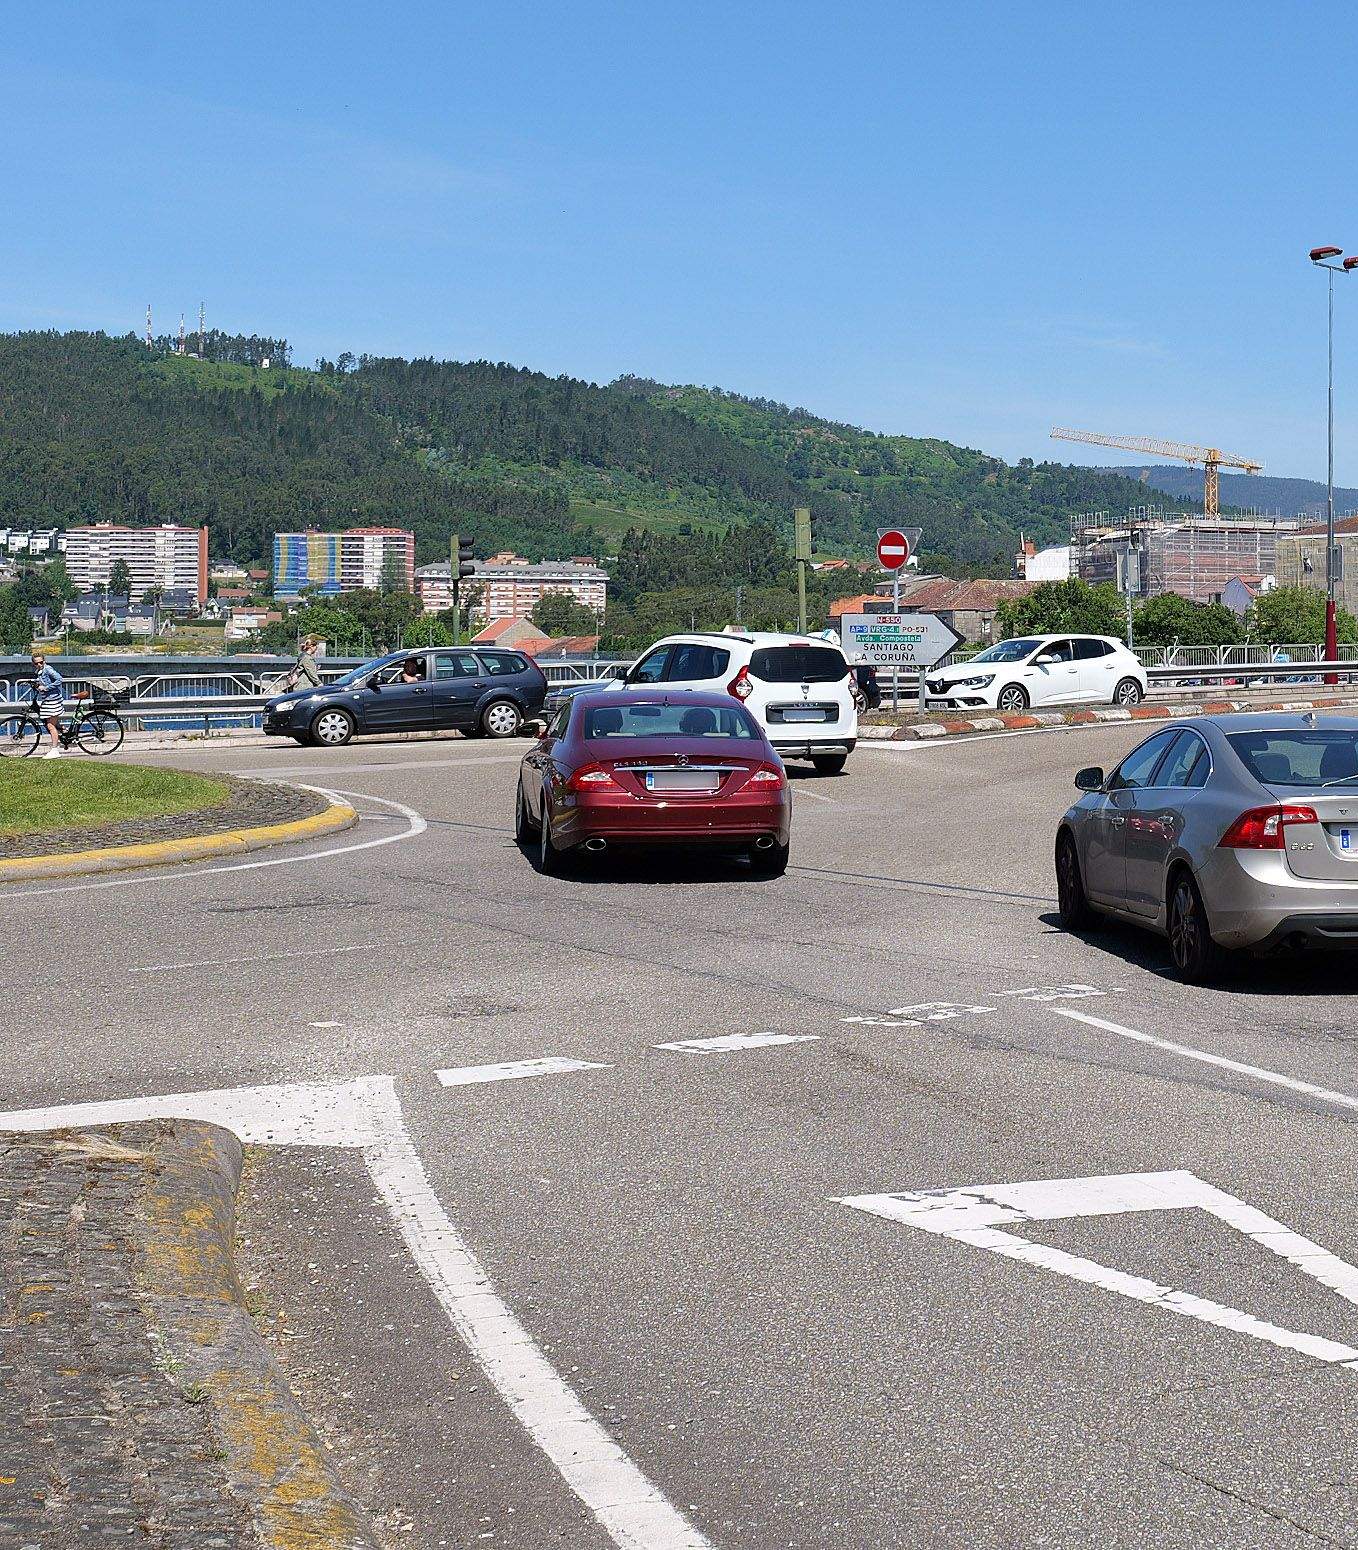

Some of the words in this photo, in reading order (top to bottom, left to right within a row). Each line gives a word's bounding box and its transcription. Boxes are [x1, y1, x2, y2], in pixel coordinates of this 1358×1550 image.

[877, 616, 901, 624] N-550
[850, 625, 868, 633] AP-9
[863, 643, 914, 651] SANTIAGO
[873, 652, 916, 661] CORUÑA
